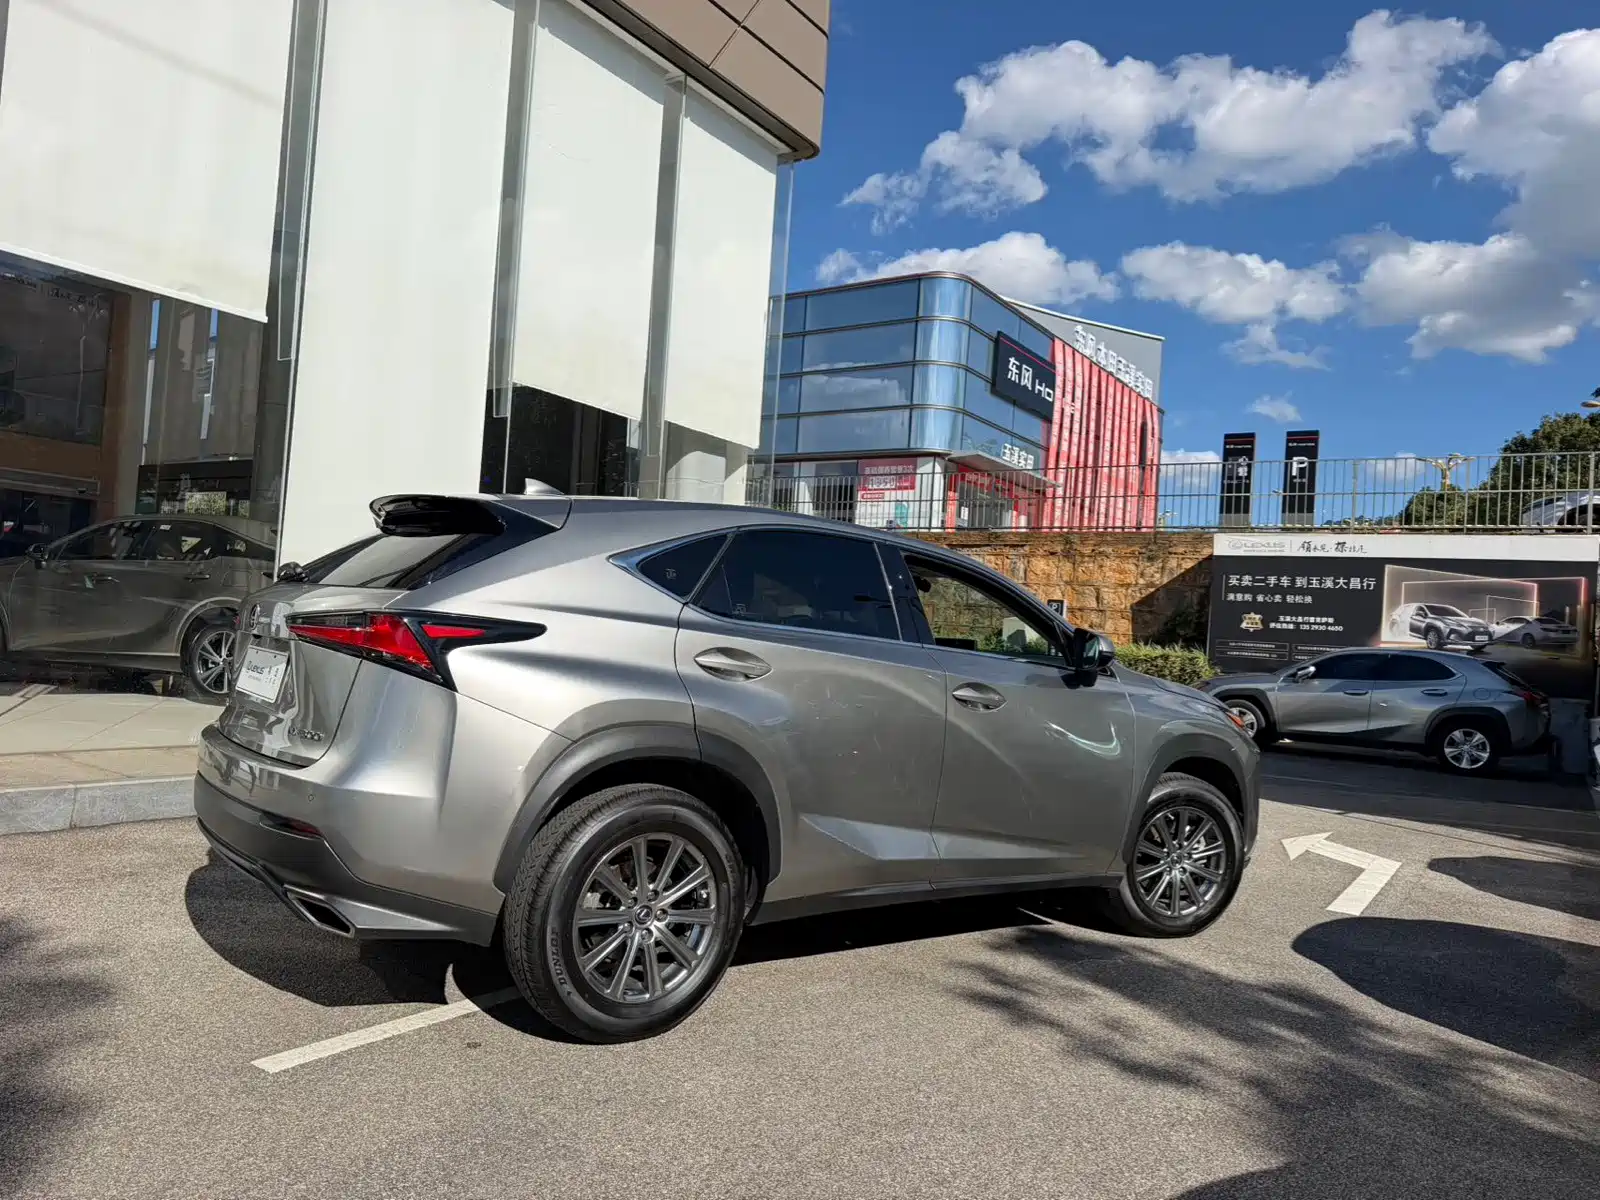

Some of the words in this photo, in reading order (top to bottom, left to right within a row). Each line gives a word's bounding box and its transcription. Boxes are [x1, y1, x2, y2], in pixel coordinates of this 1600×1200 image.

[1007, 356, 1033, 391] 东风
[1291, 456, 1308, 476] P
[1228, 574, 1292, 588] 买卖二手车
[1295, 575, 1377, 590] 到玉溪大昌行
[1256, 593, 1282, 603] 省心卖
[1286, 594, 1313, 604] 轻松换
